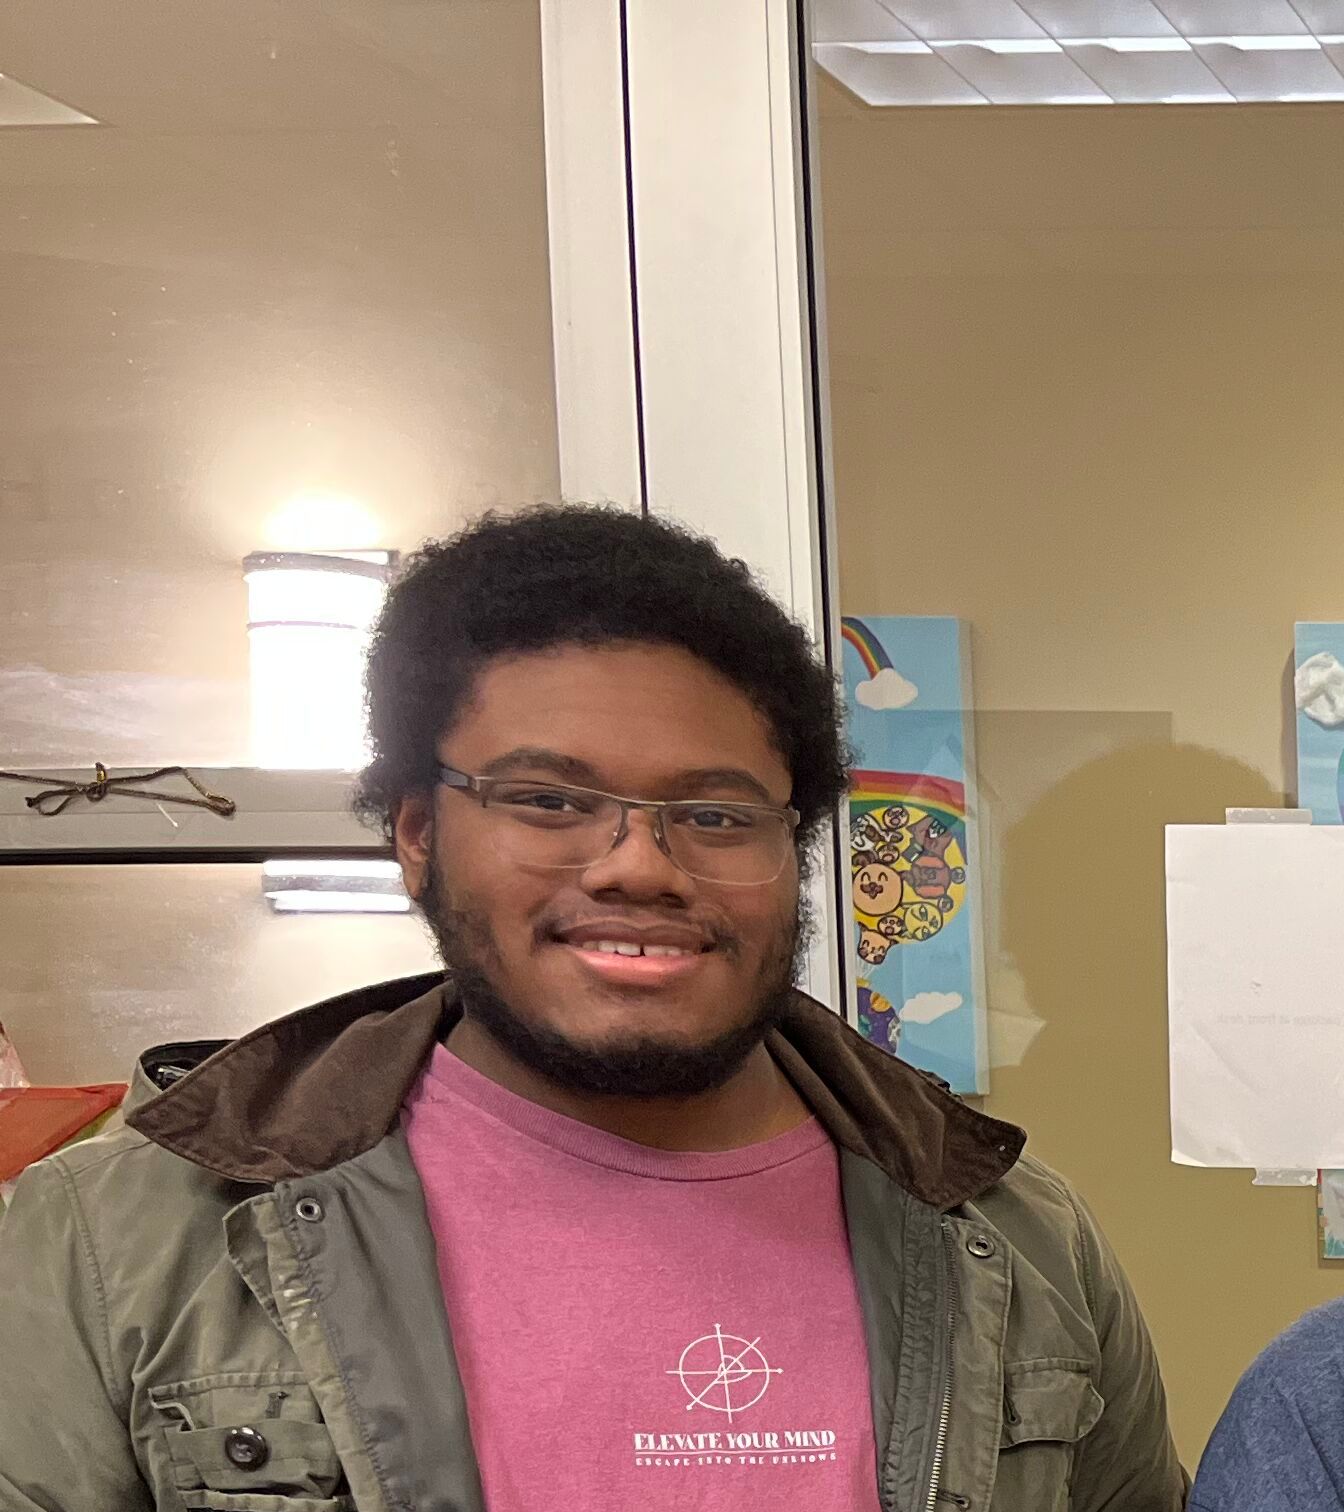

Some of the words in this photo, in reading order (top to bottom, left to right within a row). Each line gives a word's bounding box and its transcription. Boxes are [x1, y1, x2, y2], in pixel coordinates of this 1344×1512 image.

[634, 1432, 723, 1451] ELEVATE
[726, 1432, 780, 1449] YOUR
[784, 1430, 836, 1447] MIND
[635, 1456, 690, 1467] ESCAPE
[698, 1455, 732, 1466] INTO
[739, 1456, 764, 1465] THE
[772, 1452, 837, 1464] UNKNOWN
